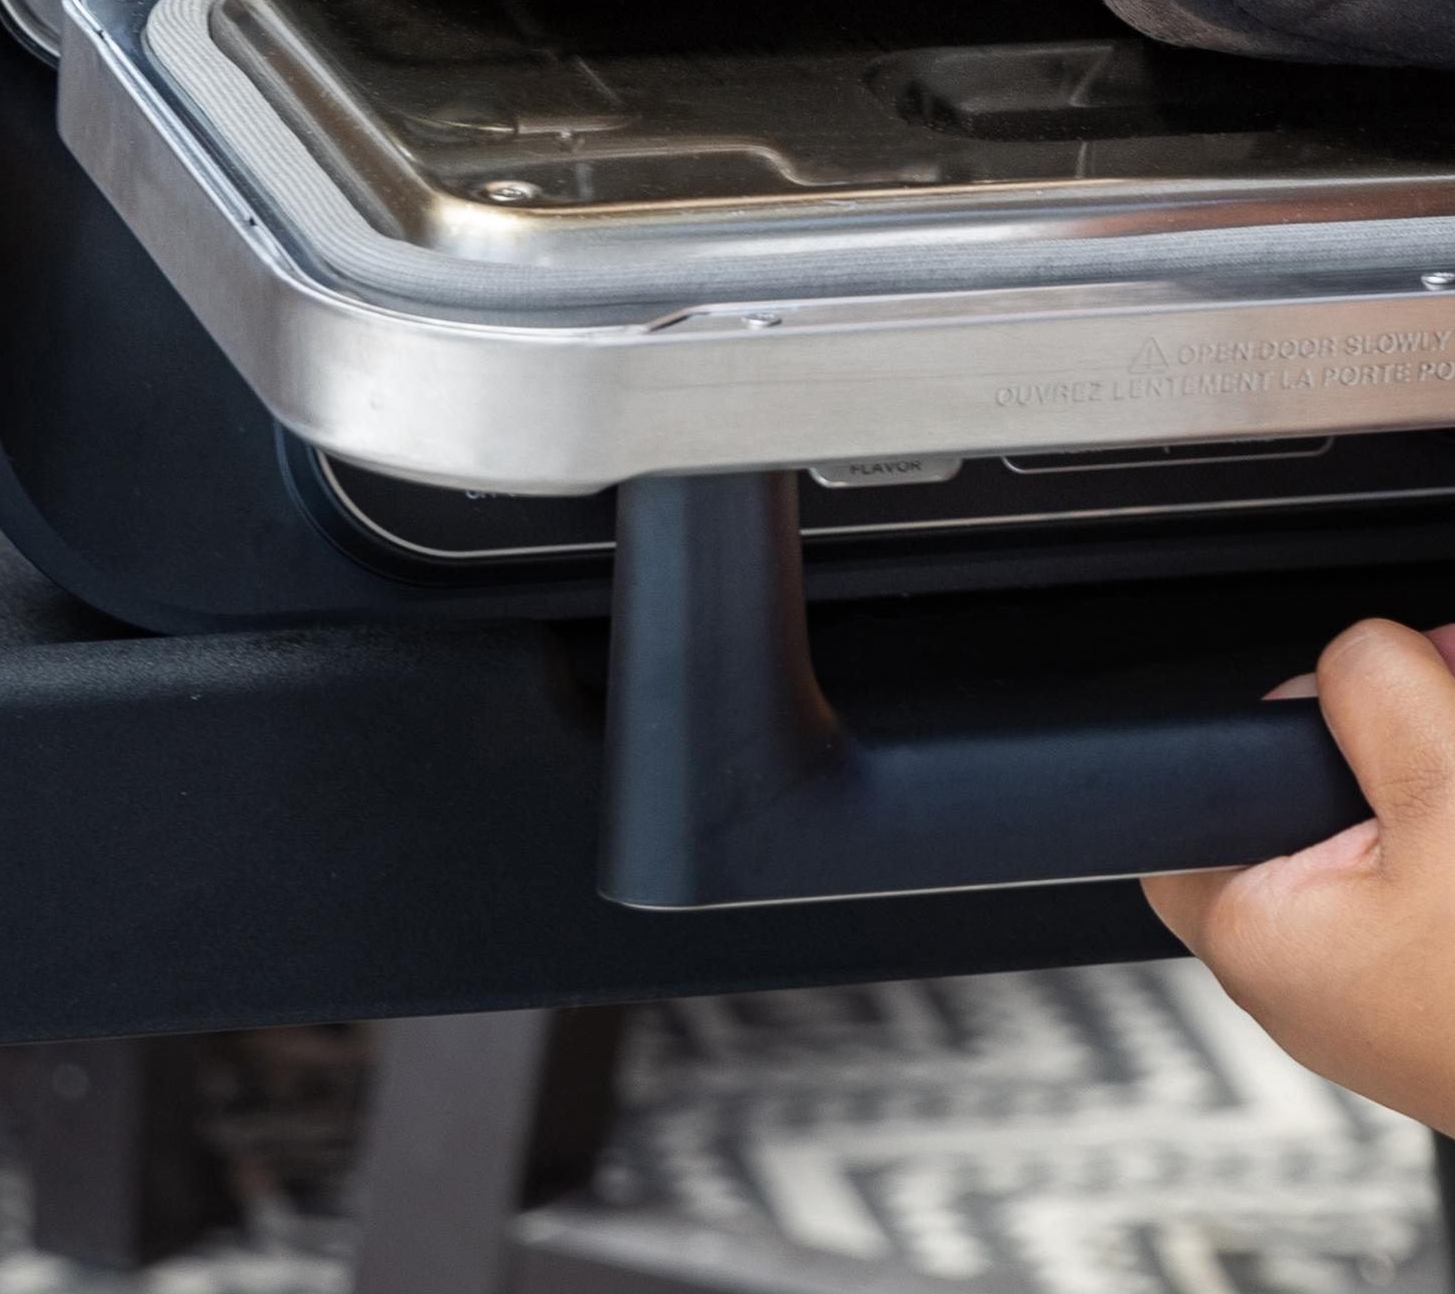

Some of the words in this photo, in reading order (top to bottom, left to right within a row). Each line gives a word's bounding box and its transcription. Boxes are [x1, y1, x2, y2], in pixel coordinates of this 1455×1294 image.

[1177, 341, 1254, 366] OPEN
[1257, 337, 1338, 361] DOOR
[1344, 330, 1449, 356] SLOWLY
[995, 380, 1103, 407] OUVREZ
[1112, 372, 1275, 401] LENTEMENT
[1281, 368, 1315, 391] LA
[1321, 362, 1412, 388] PORTE
[850, 460, 921, 475] FLAVOR
